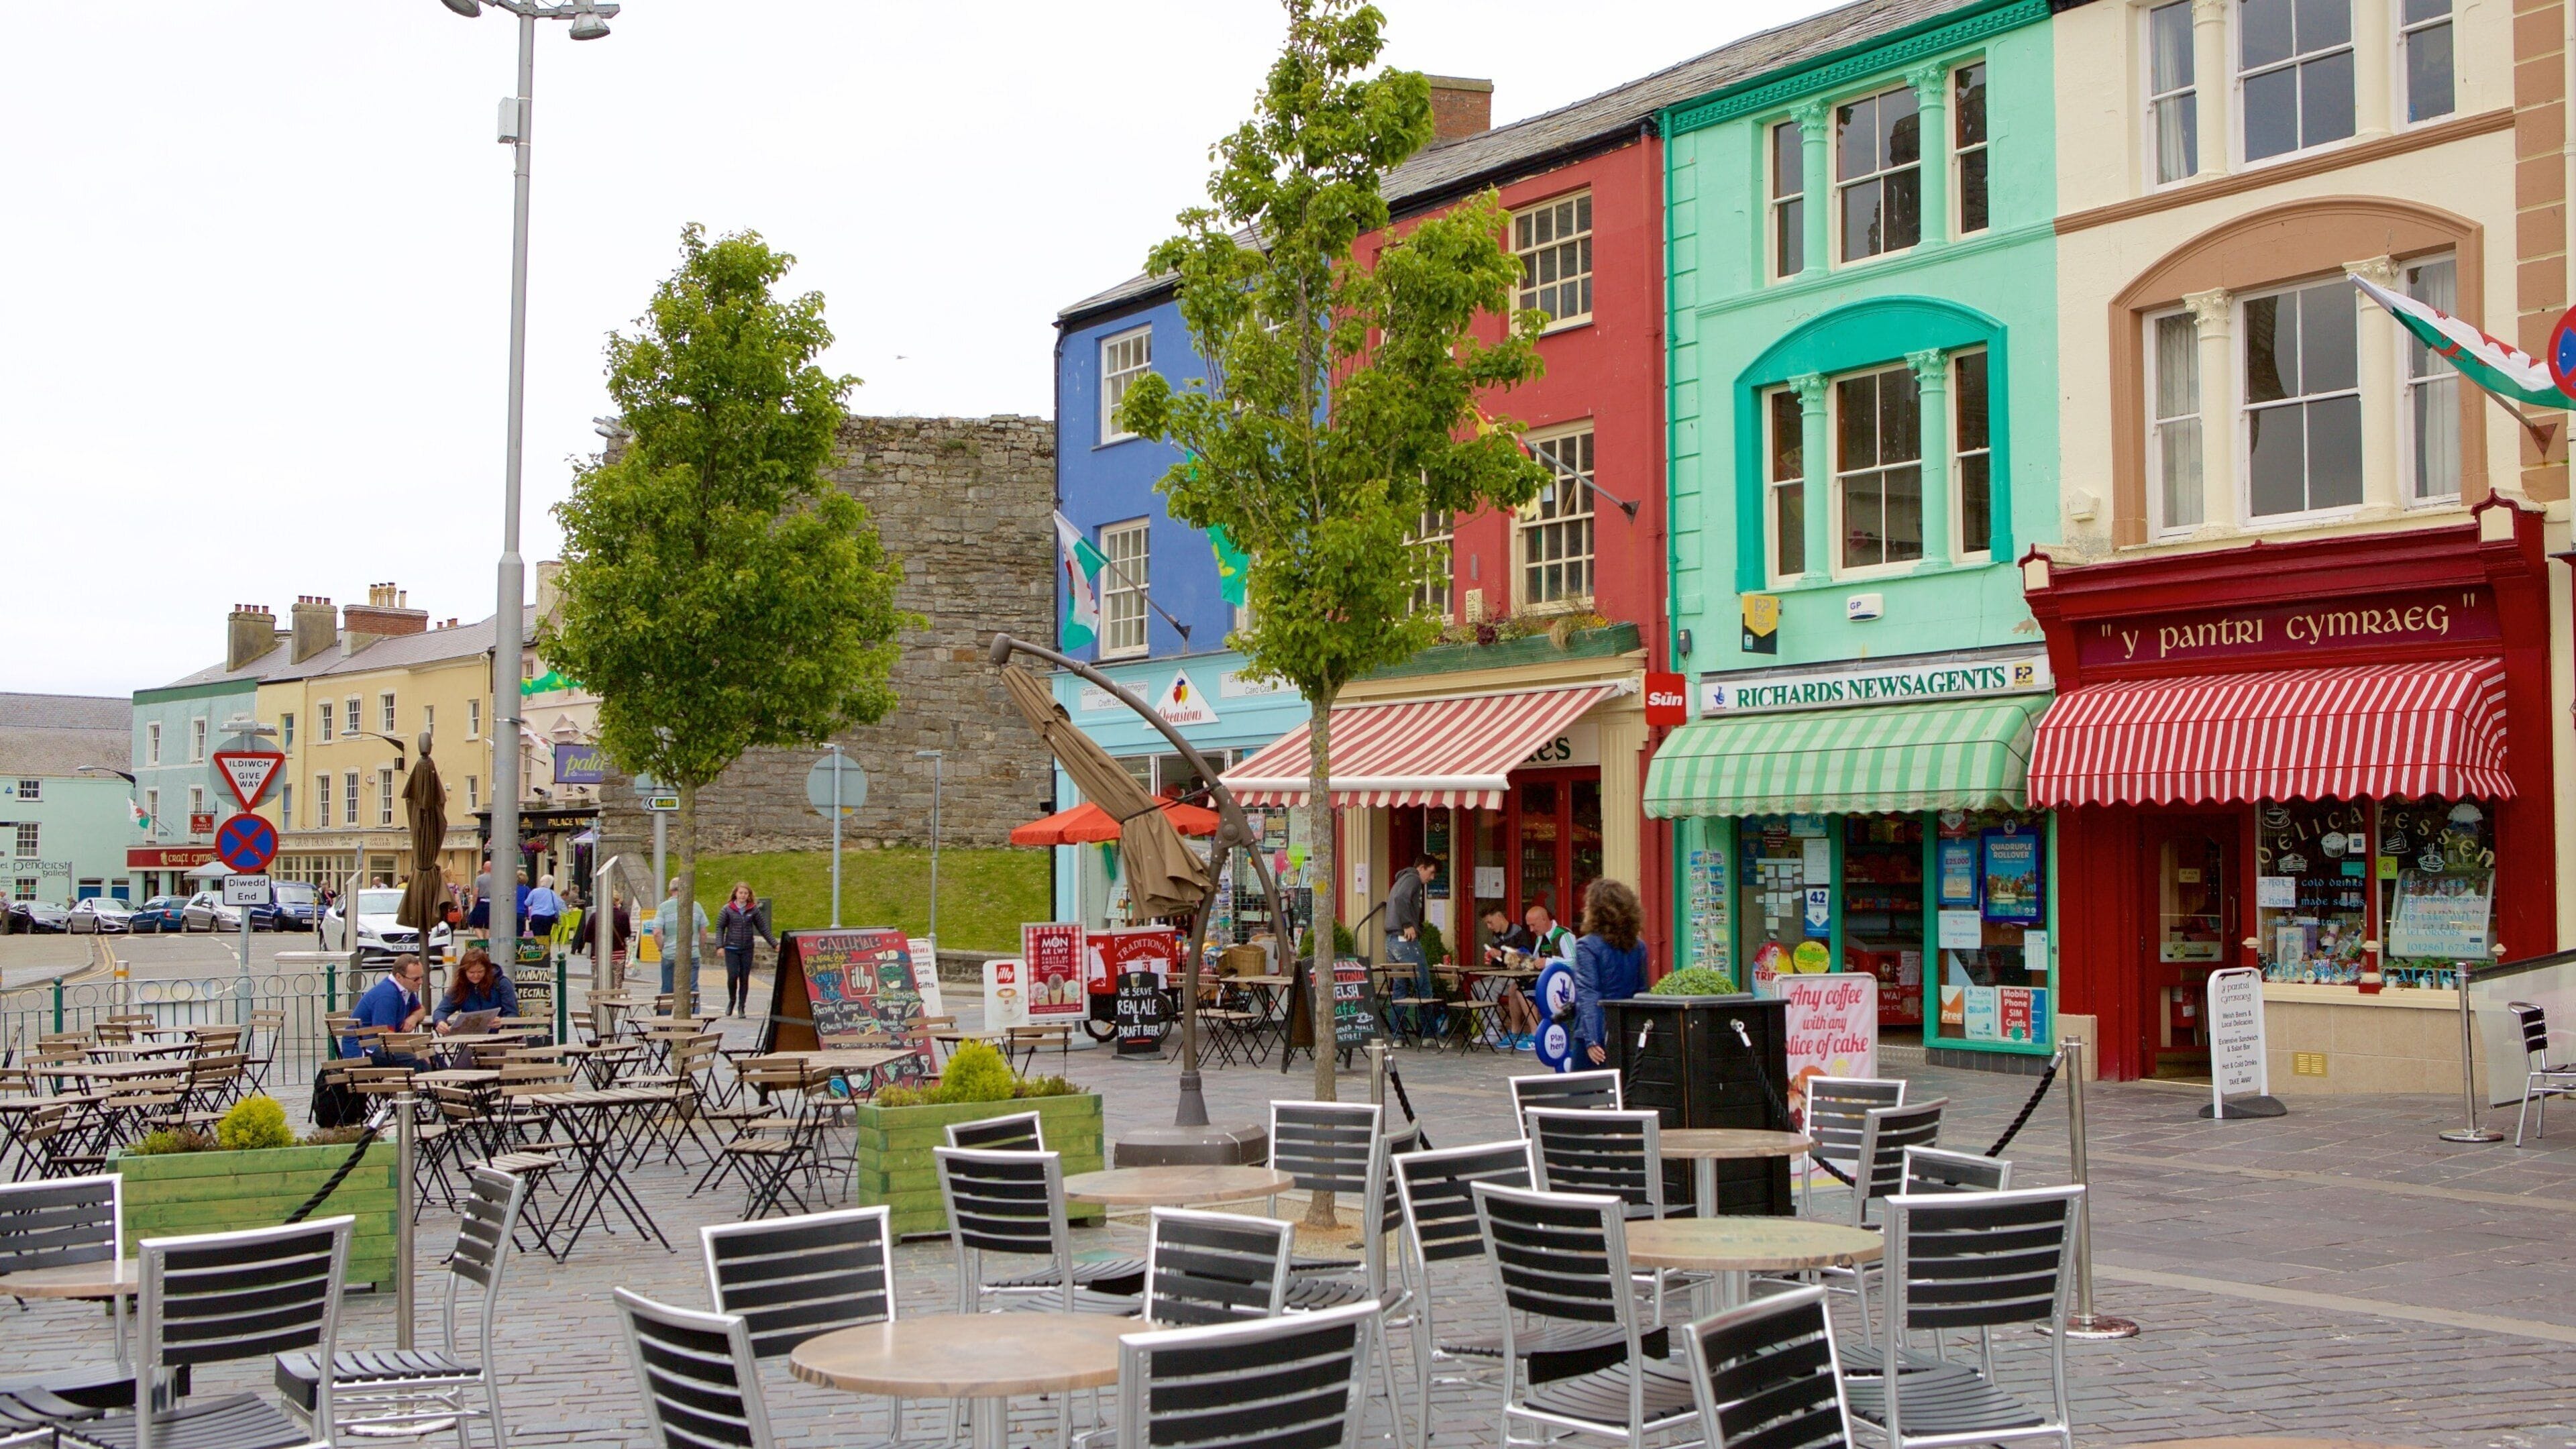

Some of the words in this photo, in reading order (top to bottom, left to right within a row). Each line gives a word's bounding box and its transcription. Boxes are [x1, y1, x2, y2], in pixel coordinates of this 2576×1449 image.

[1736, 680, 1844, 708] RICHARDS
[1847, 665, 2006, 700] NEWSAGENTS
[1159, 706, 1202, 722] Occasions
[547, 818, 574, 826] PALACE
[1990, 843, 2033, 851] QUADRUPLE
[1993, 851, 2029, 859] ROLLOVER
[229, 879, 266, 887] Diwedd
[237, 892, 256, 900] End
[1810, 891, 1826, 903] 42
[1116, 938, 1171, 959] TRADITIONAL
[515, 969, 550, 981] WANWYN
[998, 967, 1013, 981] illy
[1120, 988, 1130, 997] WE
[1132, 987, 1152, 996] SERVE
[2003, 989, 2029, 998] Mobile
[1790, 984, 1822, 1012] Any
[1825, 983, 1863, 1012] coffee
[1117, 1000, 1140, 1015] REAL
[1140, 1000, 1157, 1015] ALE
[2004, 1000, 2027, 1008] Phone
[1336, 1001, 1358, 1020] afé
[1941, 1010, 1962, 1020] Free
[2009, 1009, 2023, 1017] SIM
[1133, 1016, 1140, 1024] &
[1803, 1016, 1826, 1030] with
[1828, 1018, 1847, 1033] any
[2006, 1019, 2027, 1028] Cards
[2233, 1019, 2253, 1027] Delicacies
[1118, 1025, 1142, 1038] DRAFT
[1143, 1024, 1160, 1036] BEER
[1550, 1034, 1564, 1042] Play
[2239, 1034, 2259, 1042] Sandwich
[1816, 1032, 1833, 1061] of
[1833, 1032, 1868, 1054] cake
[2235, 1061, 2244, 1069] Cold
[2245, 1059, 2257, 1067] Drinks
[2229, 1077, 2239, 1085] TAKE
[2241, 1076, 2252, 1084] AWAY
